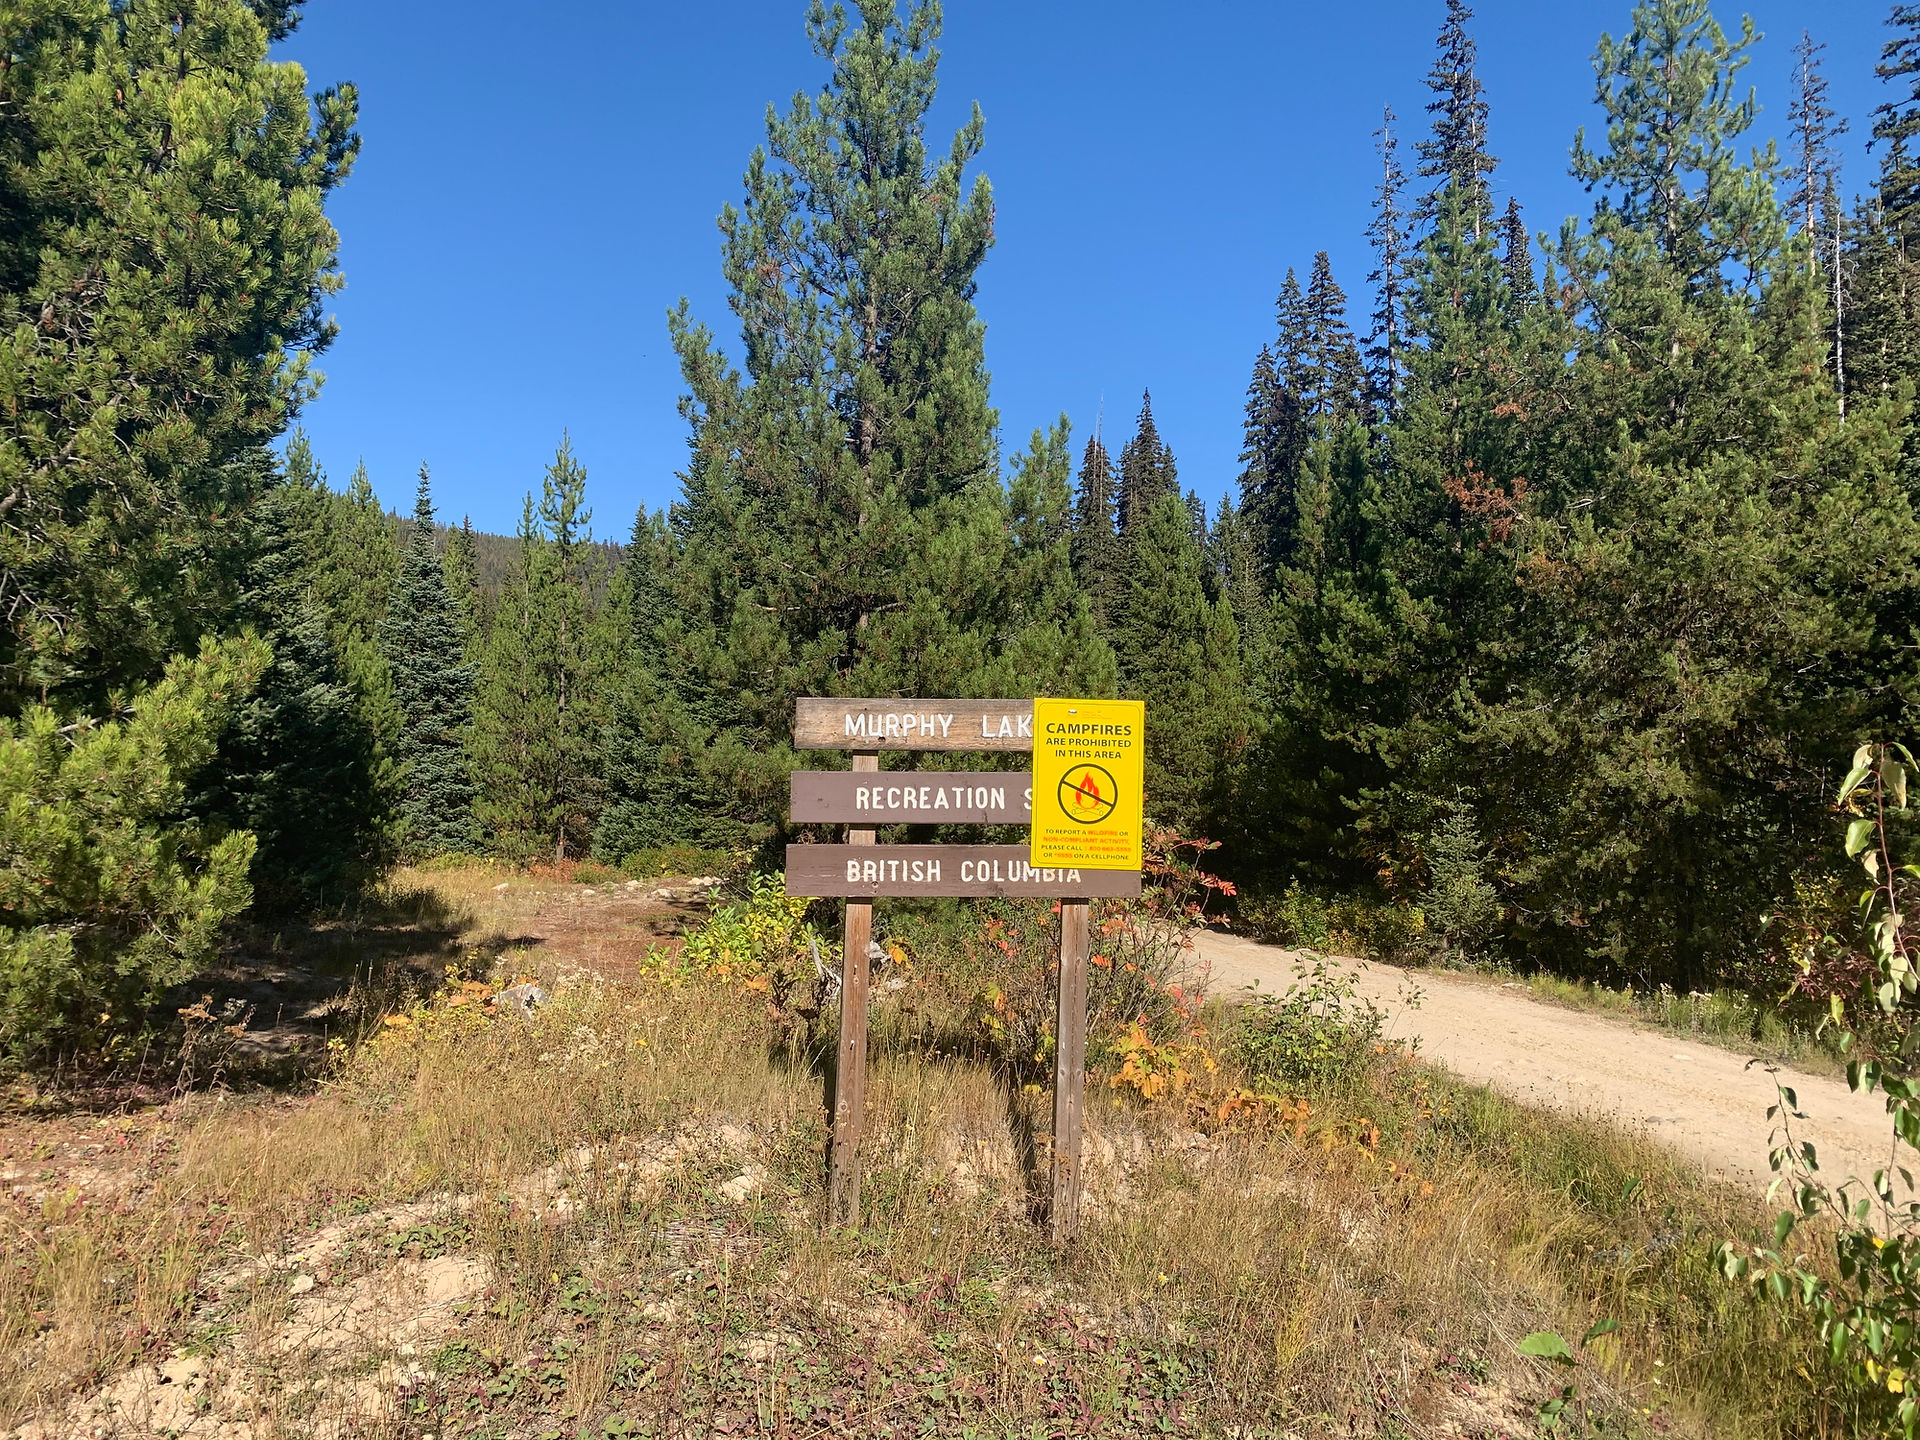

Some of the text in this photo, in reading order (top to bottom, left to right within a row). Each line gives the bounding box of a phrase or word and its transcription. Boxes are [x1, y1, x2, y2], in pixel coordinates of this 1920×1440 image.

[845, 713, 1033, 737] MURPHY LAK
[1046, 722, 1132, 736] CAMPFIRES
[1046, 738, 1132, 748] ARE PROHIBITED
[1068, 750, 1091, 758] THIS
[1094, 751, 1122, 759] AREA
[856, 787, 1005, 810] RECREATION
[846, 859, 1082, 883] BRITISH COLUMBIA
